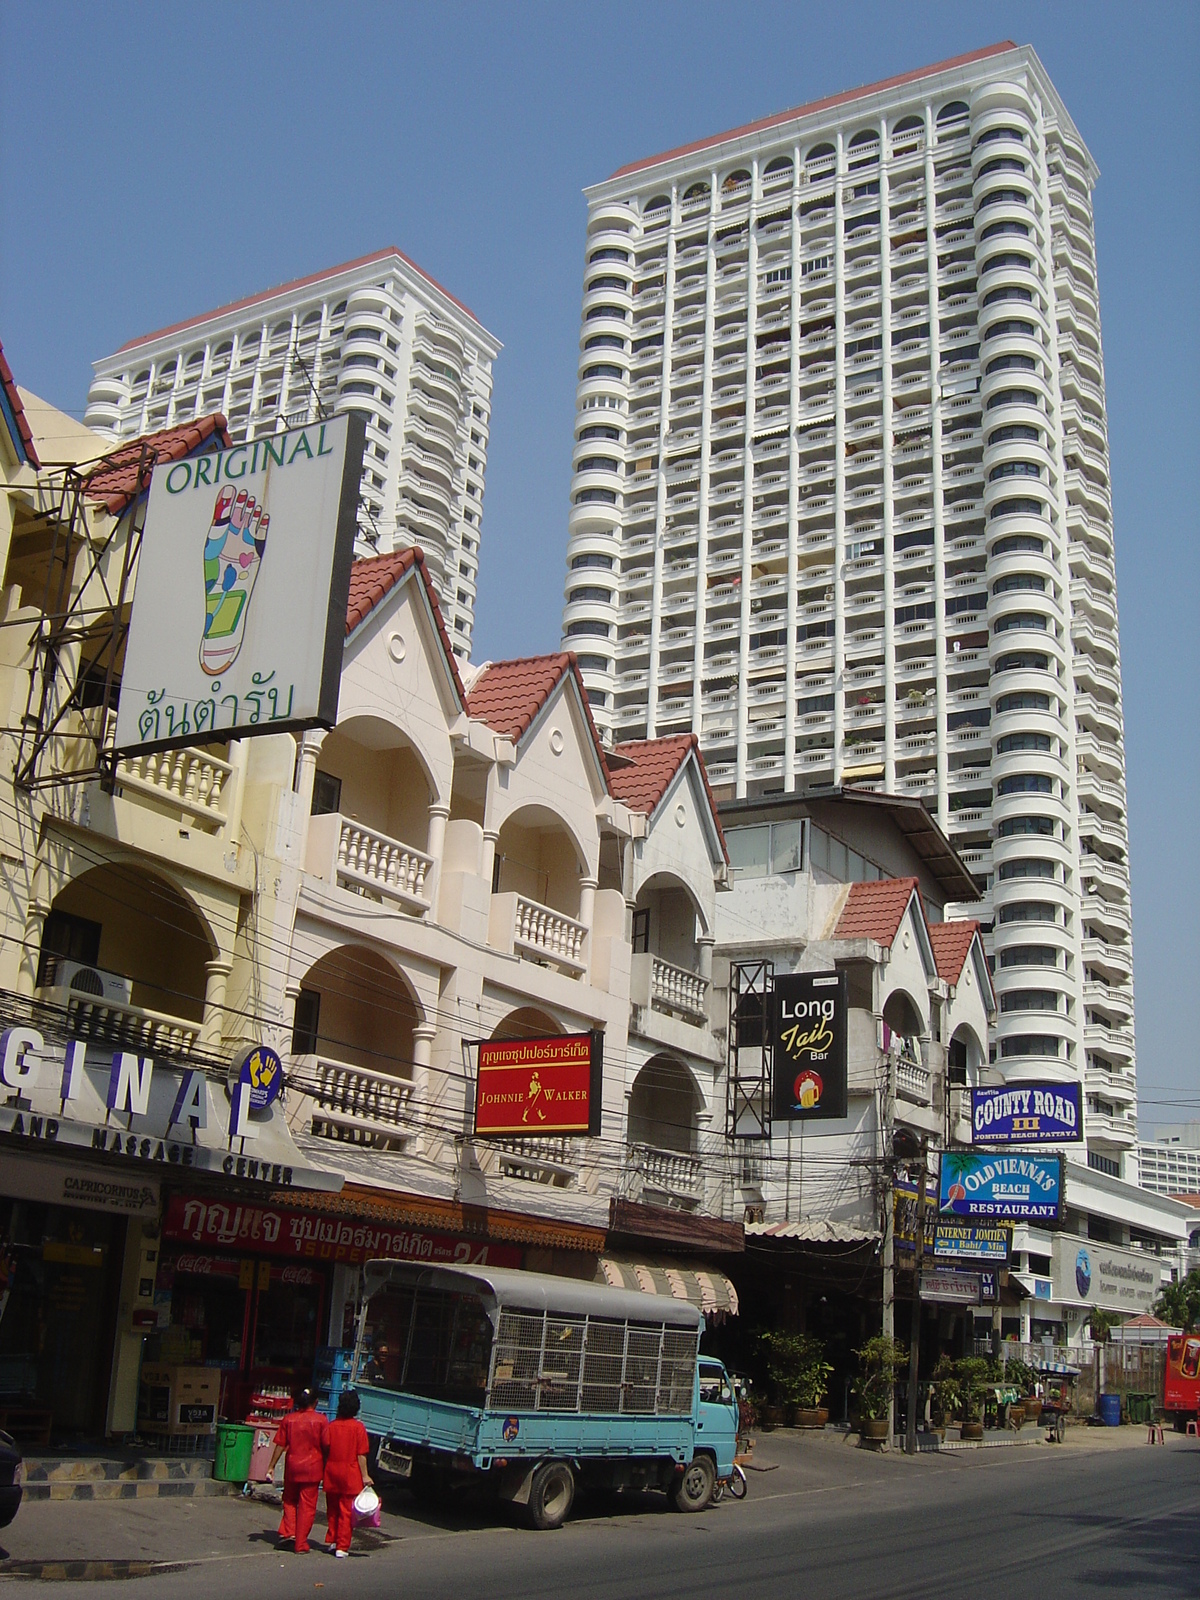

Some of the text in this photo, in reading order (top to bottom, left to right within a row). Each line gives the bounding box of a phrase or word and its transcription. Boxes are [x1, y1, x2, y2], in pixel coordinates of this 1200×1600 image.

[165, 425, 333, 495] ORIGINAL
[138, 670, 294, 741] ต้นตำรับ
[782, 1000, 834, 1020] Long
[781, 1015, 833, 1052] Tail
[482, 1042, 589, 1065] กุญแจซุปเปอร์มาร์เก็ต
[810, 1052, 828, 1060] Bar
[975, 1090, 1076, 1131] COUNTY ROAD
[1012, 1117, 1040, 1130] III
[11, 1114, 294, 1185] AND MASSAGE CENTER
[964, 1159, 1056, 1191] OLD VIENNA'S
[64, 1177, 140, 1200] CAPRICORNUS
[992, 1183, 1030, 1194] BEACH
[969, 1203, 1056, 1216] RESTAURANT
[182, 1199, 282, 1243] กุญแจ
[289, 1217, 434, 1257] ซุปเปอร์มาร์เก็ต
[936, 1226, 1007, 1241] INTERNET JOMTIEN
[987, 1242, 1004, 1251] Min
